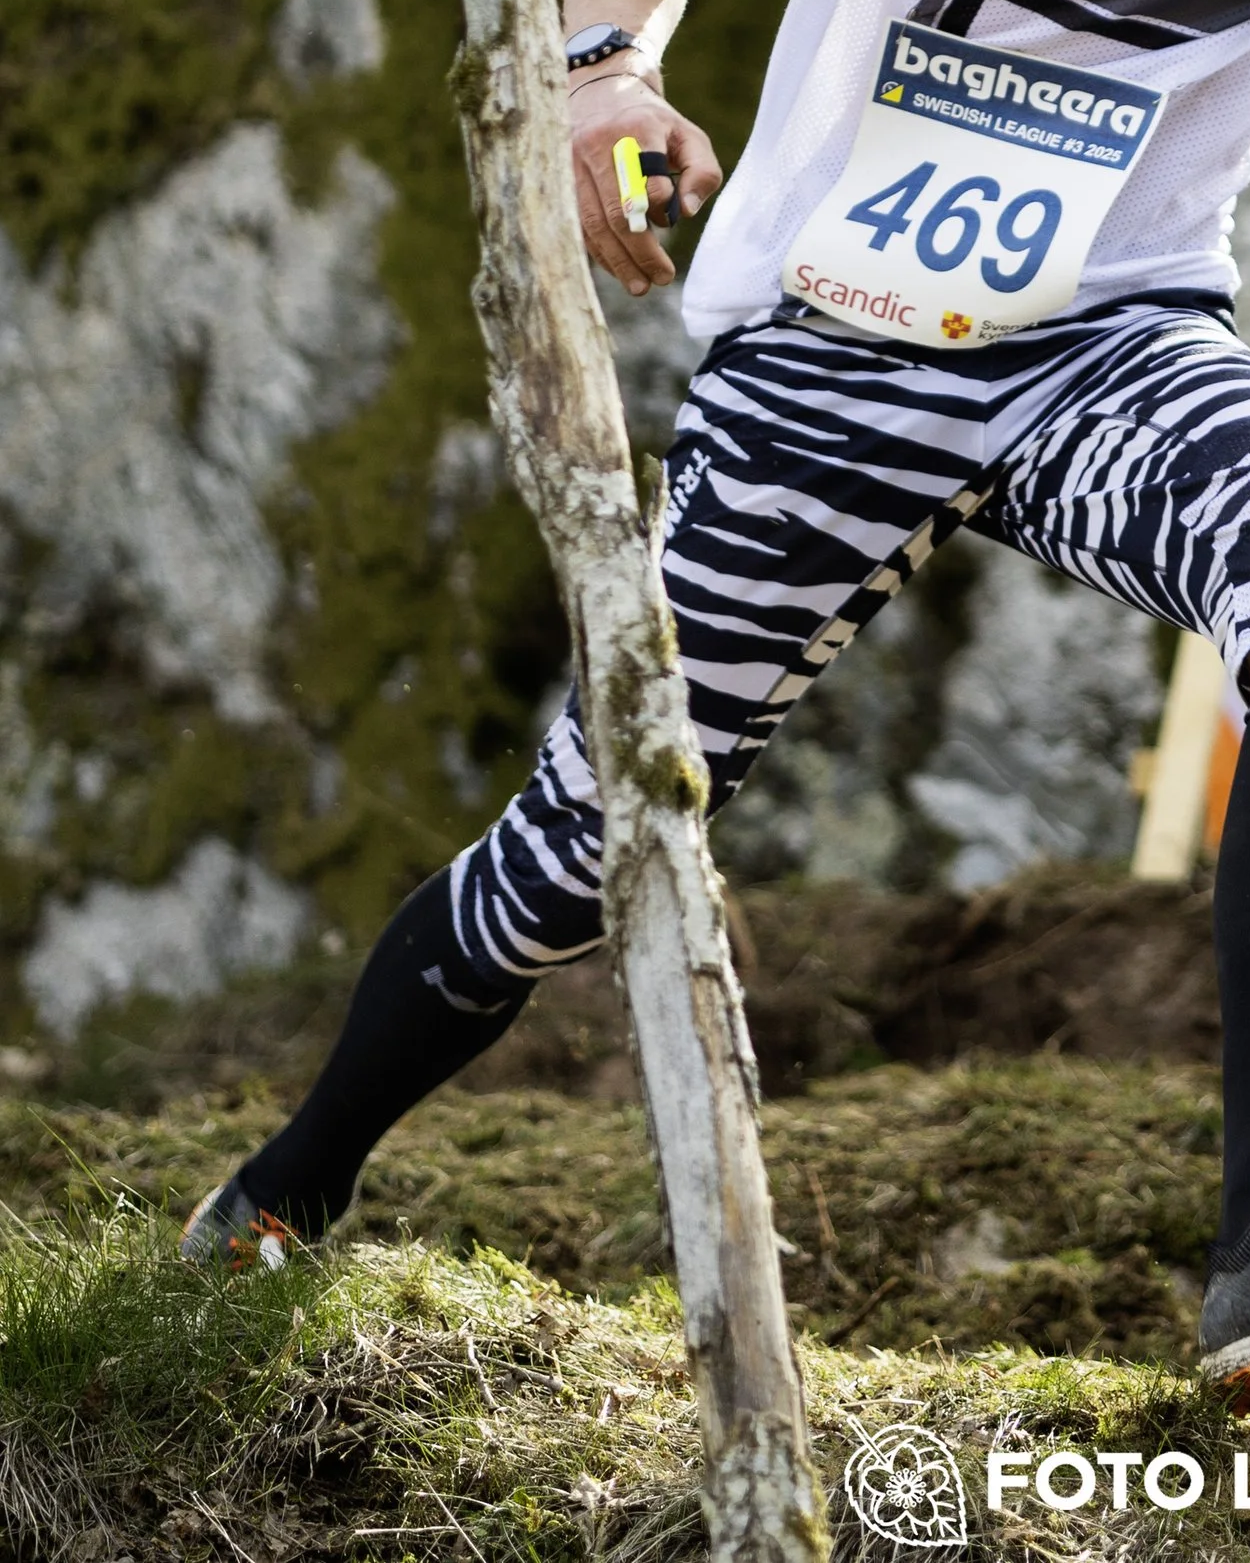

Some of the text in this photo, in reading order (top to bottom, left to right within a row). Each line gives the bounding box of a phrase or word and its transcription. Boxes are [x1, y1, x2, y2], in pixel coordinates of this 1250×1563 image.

[893, 36, 1145, 137] bagheera
[913, 92, 1123, 162] SWEDISH LEAGUE #3 2025
[844, 161, 1062, 294] 469
[794, 264, 917, 327] Scandic
[665, 447, 711, 539] TRIM
